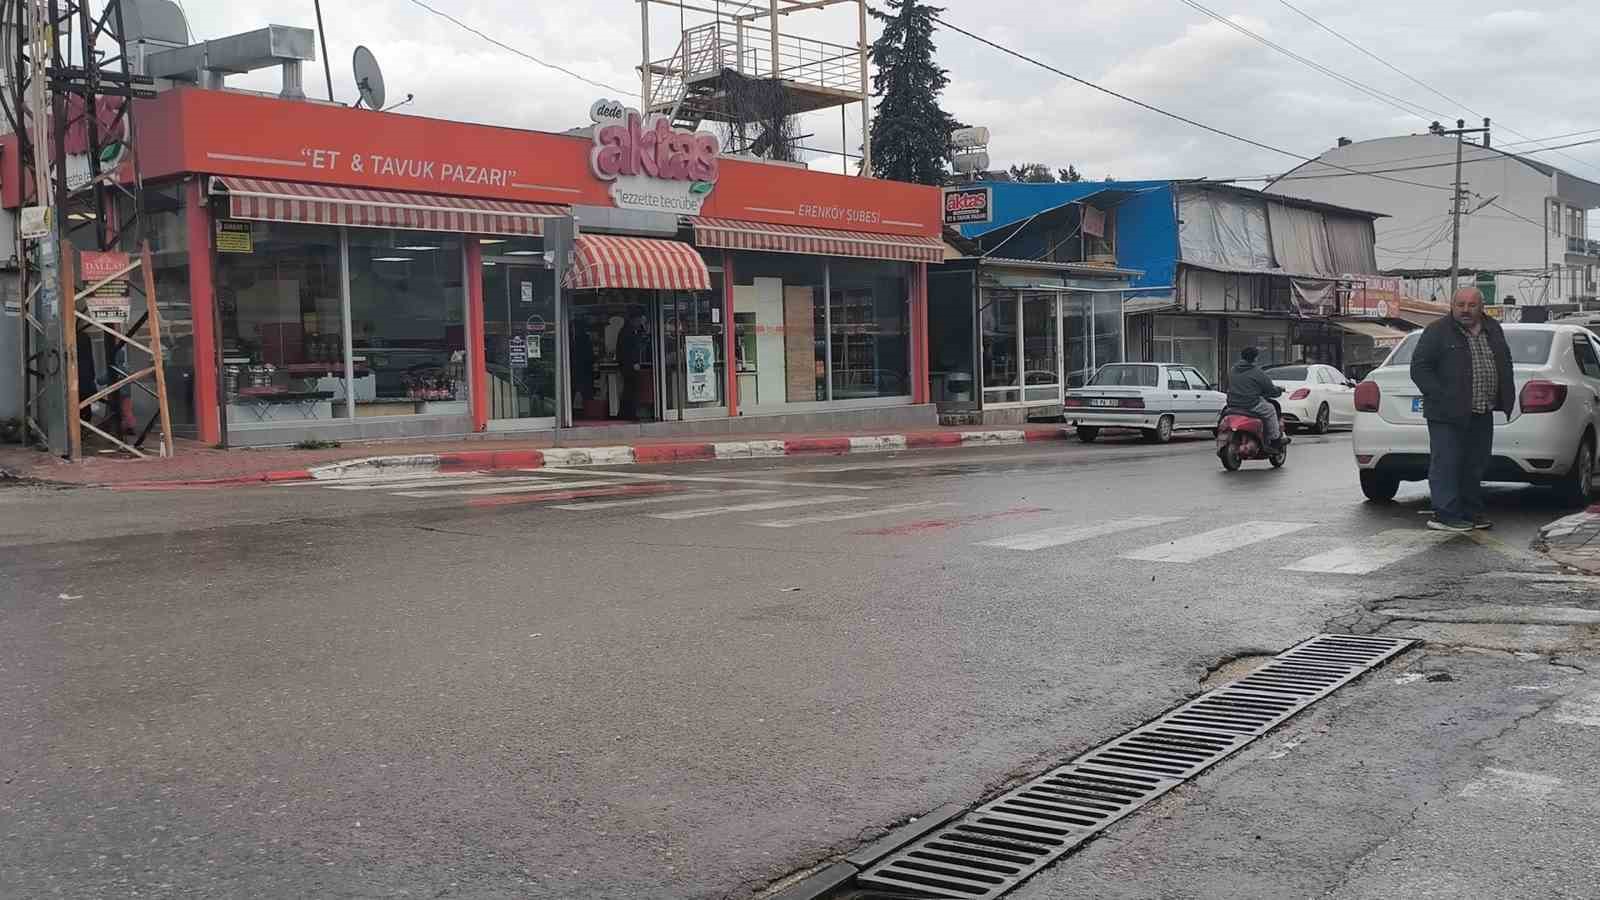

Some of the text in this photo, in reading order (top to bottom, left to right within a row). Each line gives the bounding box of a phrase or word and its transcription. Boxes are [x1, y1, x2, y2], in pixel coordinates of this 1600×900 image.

[597, 104, 622, 119] dede
[351, 153, 364, 172] &
[371, 155, 435, 179] TAVUK
